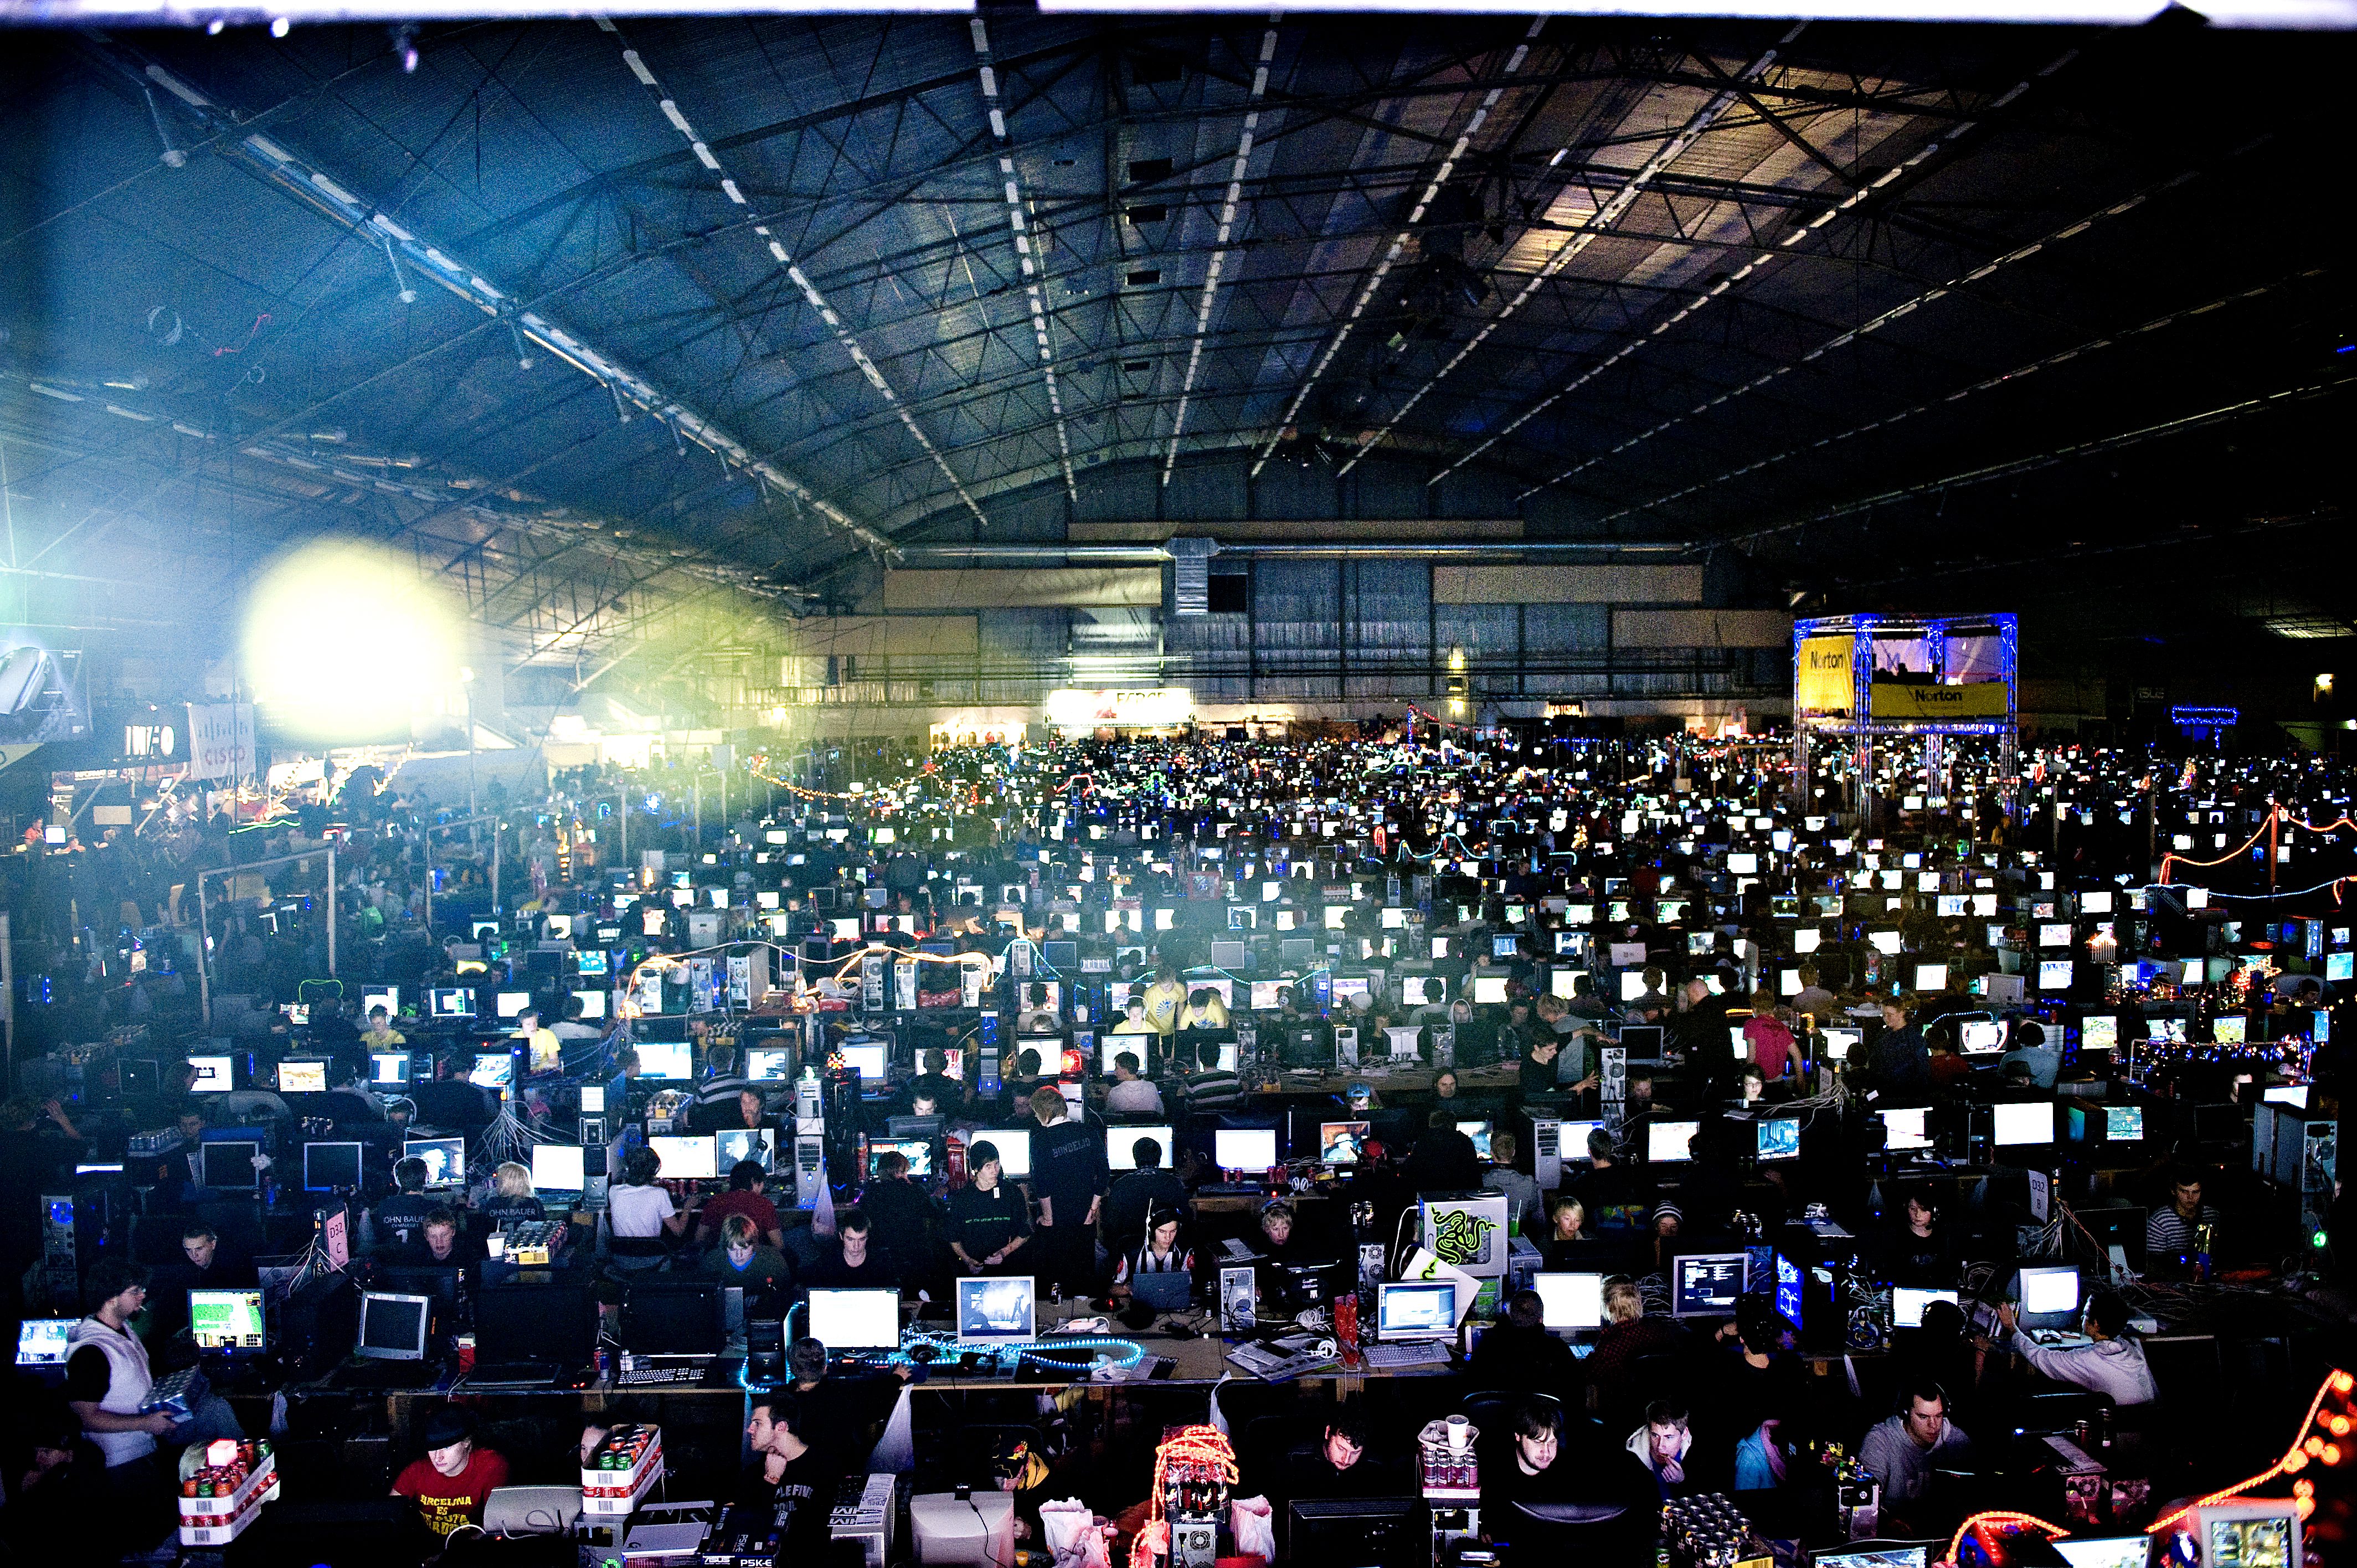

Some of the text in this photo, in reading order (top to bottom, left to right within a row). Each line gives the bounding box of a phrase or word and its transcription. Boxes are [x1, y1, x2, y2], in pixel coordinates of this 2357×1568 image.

[1810, 651, 1844, 669] Norton
[1915, 690, 1963, 702] Norton
[125, 725, 174, 755] INFO
[204, 746, 245, 765] CISCO
[2032, 1179, 2045, 1193] D32
[330, 1222, 343, 1239] D32
[337, 1242, 342, 1254] C
[436, 1506, 448, 1515] ES
